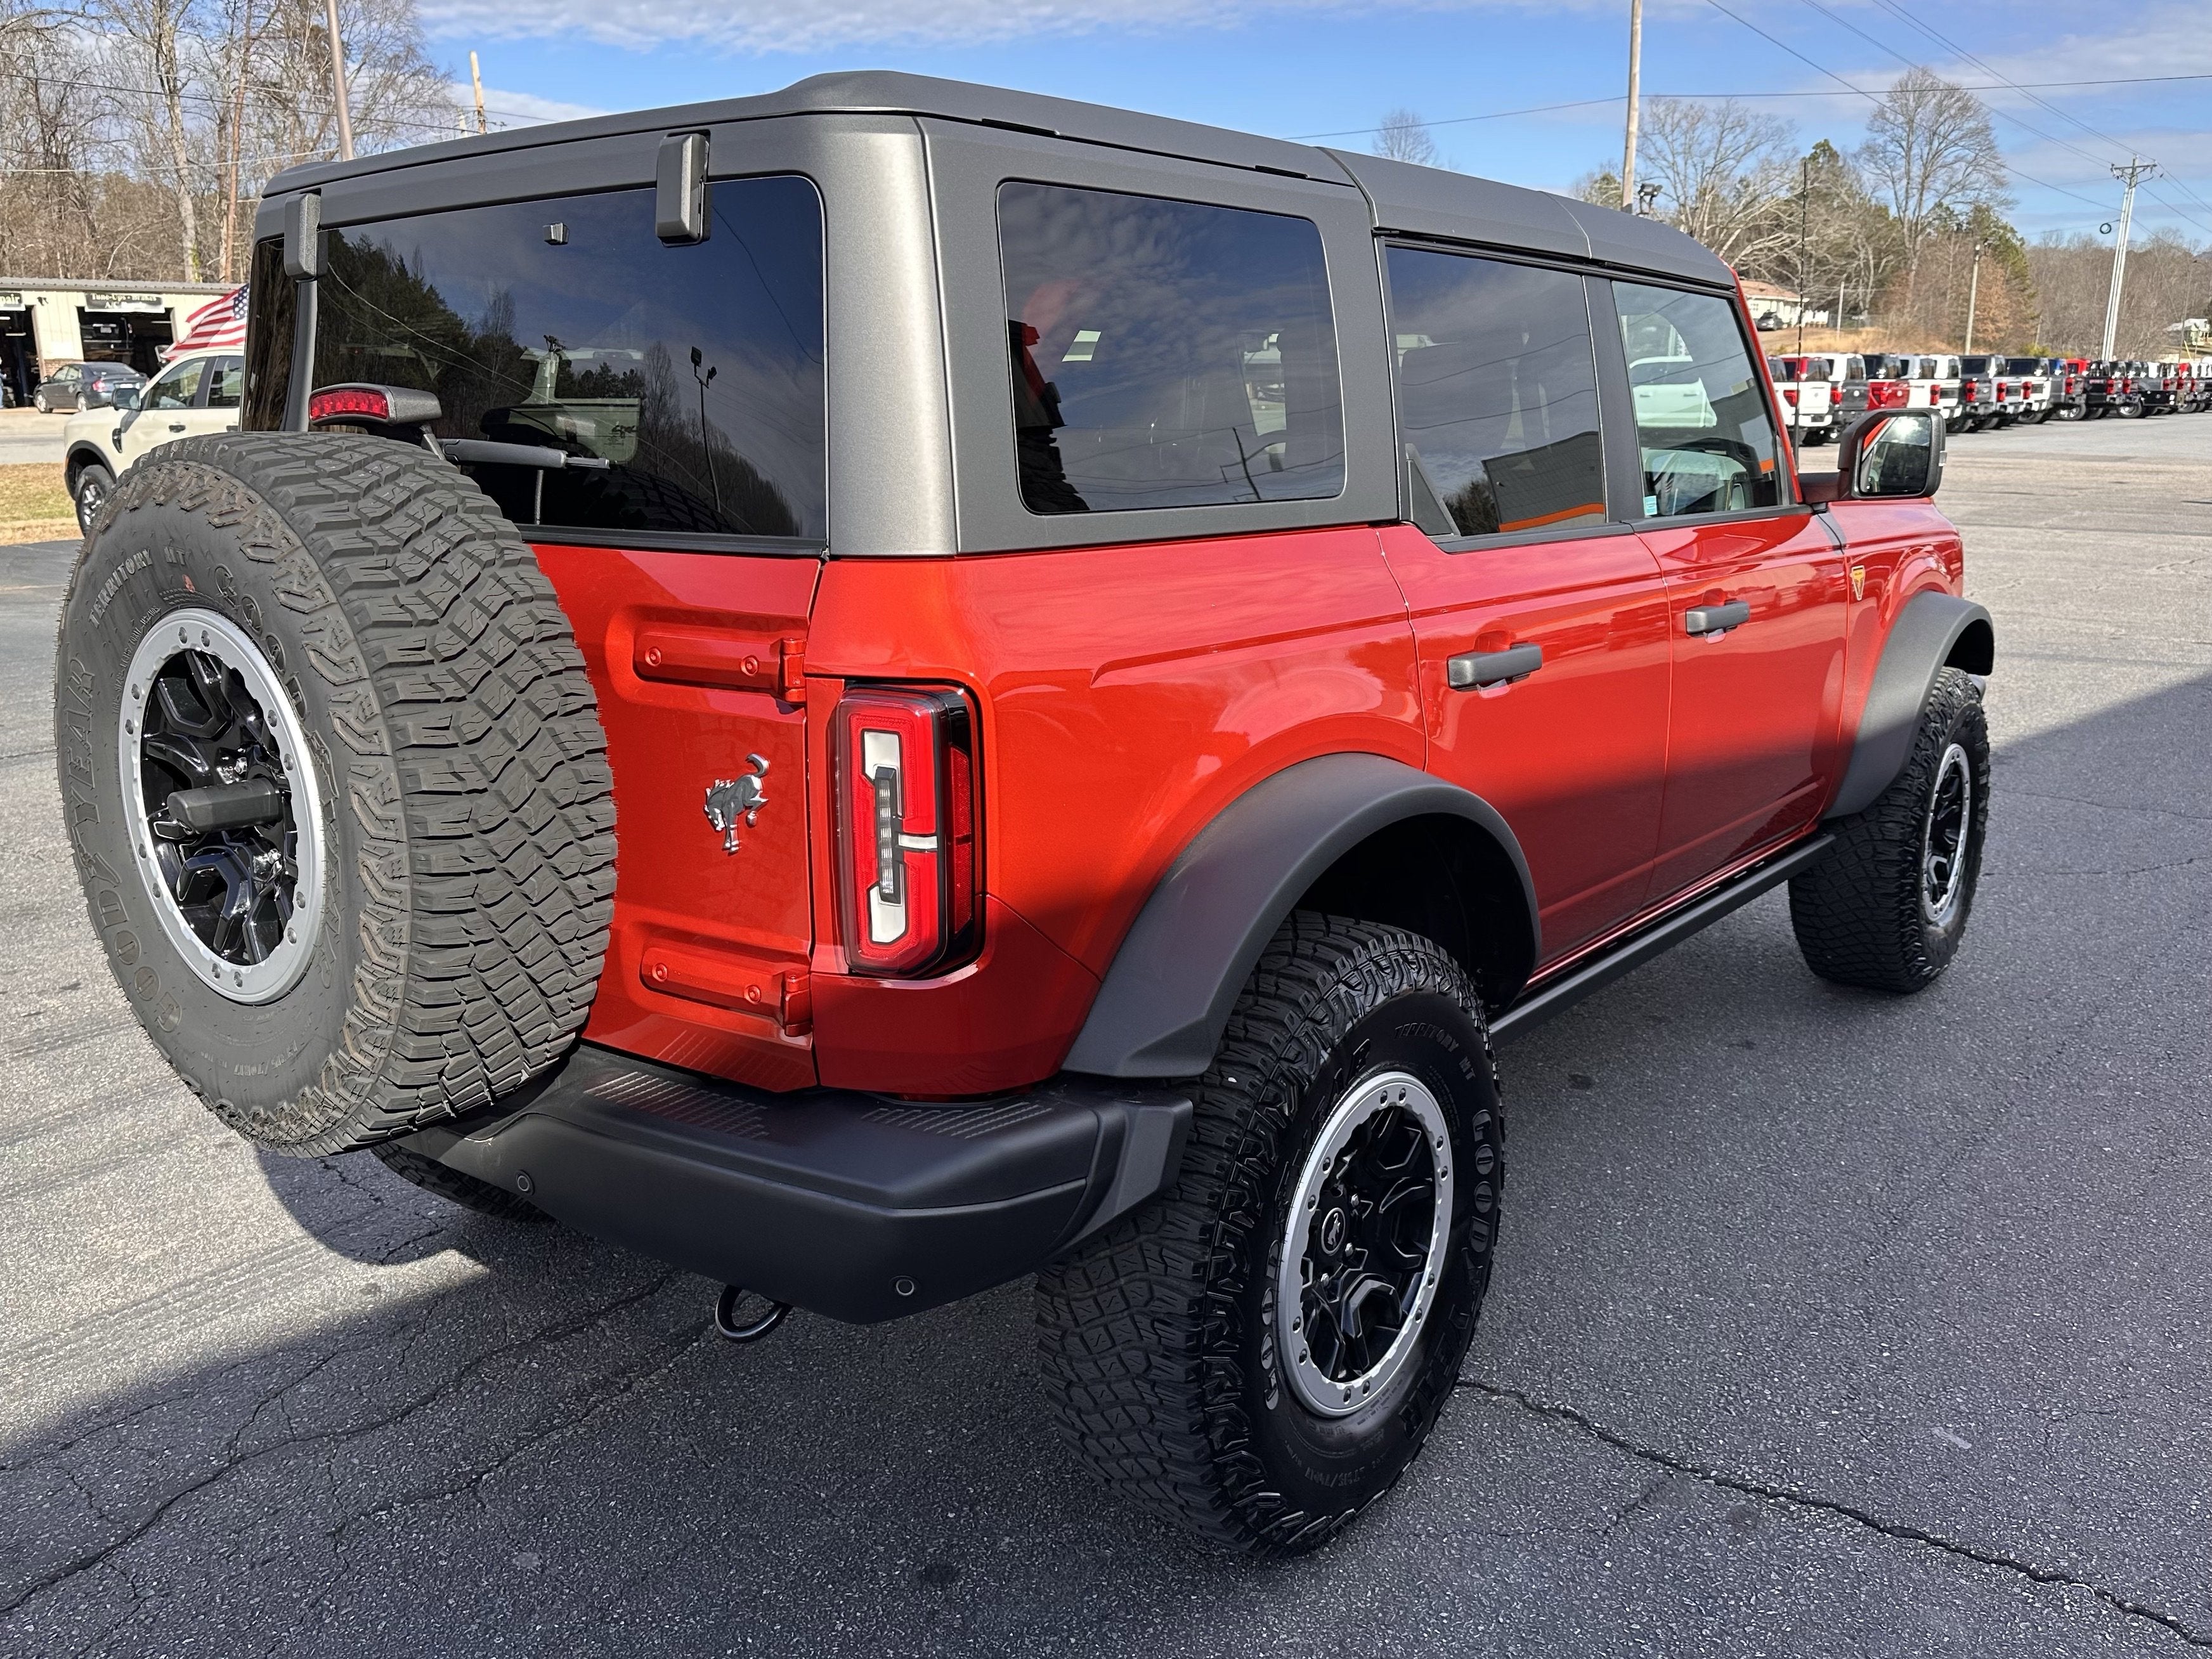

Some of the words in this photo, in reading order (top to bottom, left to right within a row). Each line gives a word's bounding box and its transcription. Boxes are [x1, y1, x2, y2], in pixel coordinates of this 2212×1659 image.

[88, 547, 153, 629] TERRITORY
[162, 545, 188, 566] MT
[1395, 1022, 1459, 1053] TERRITORY
